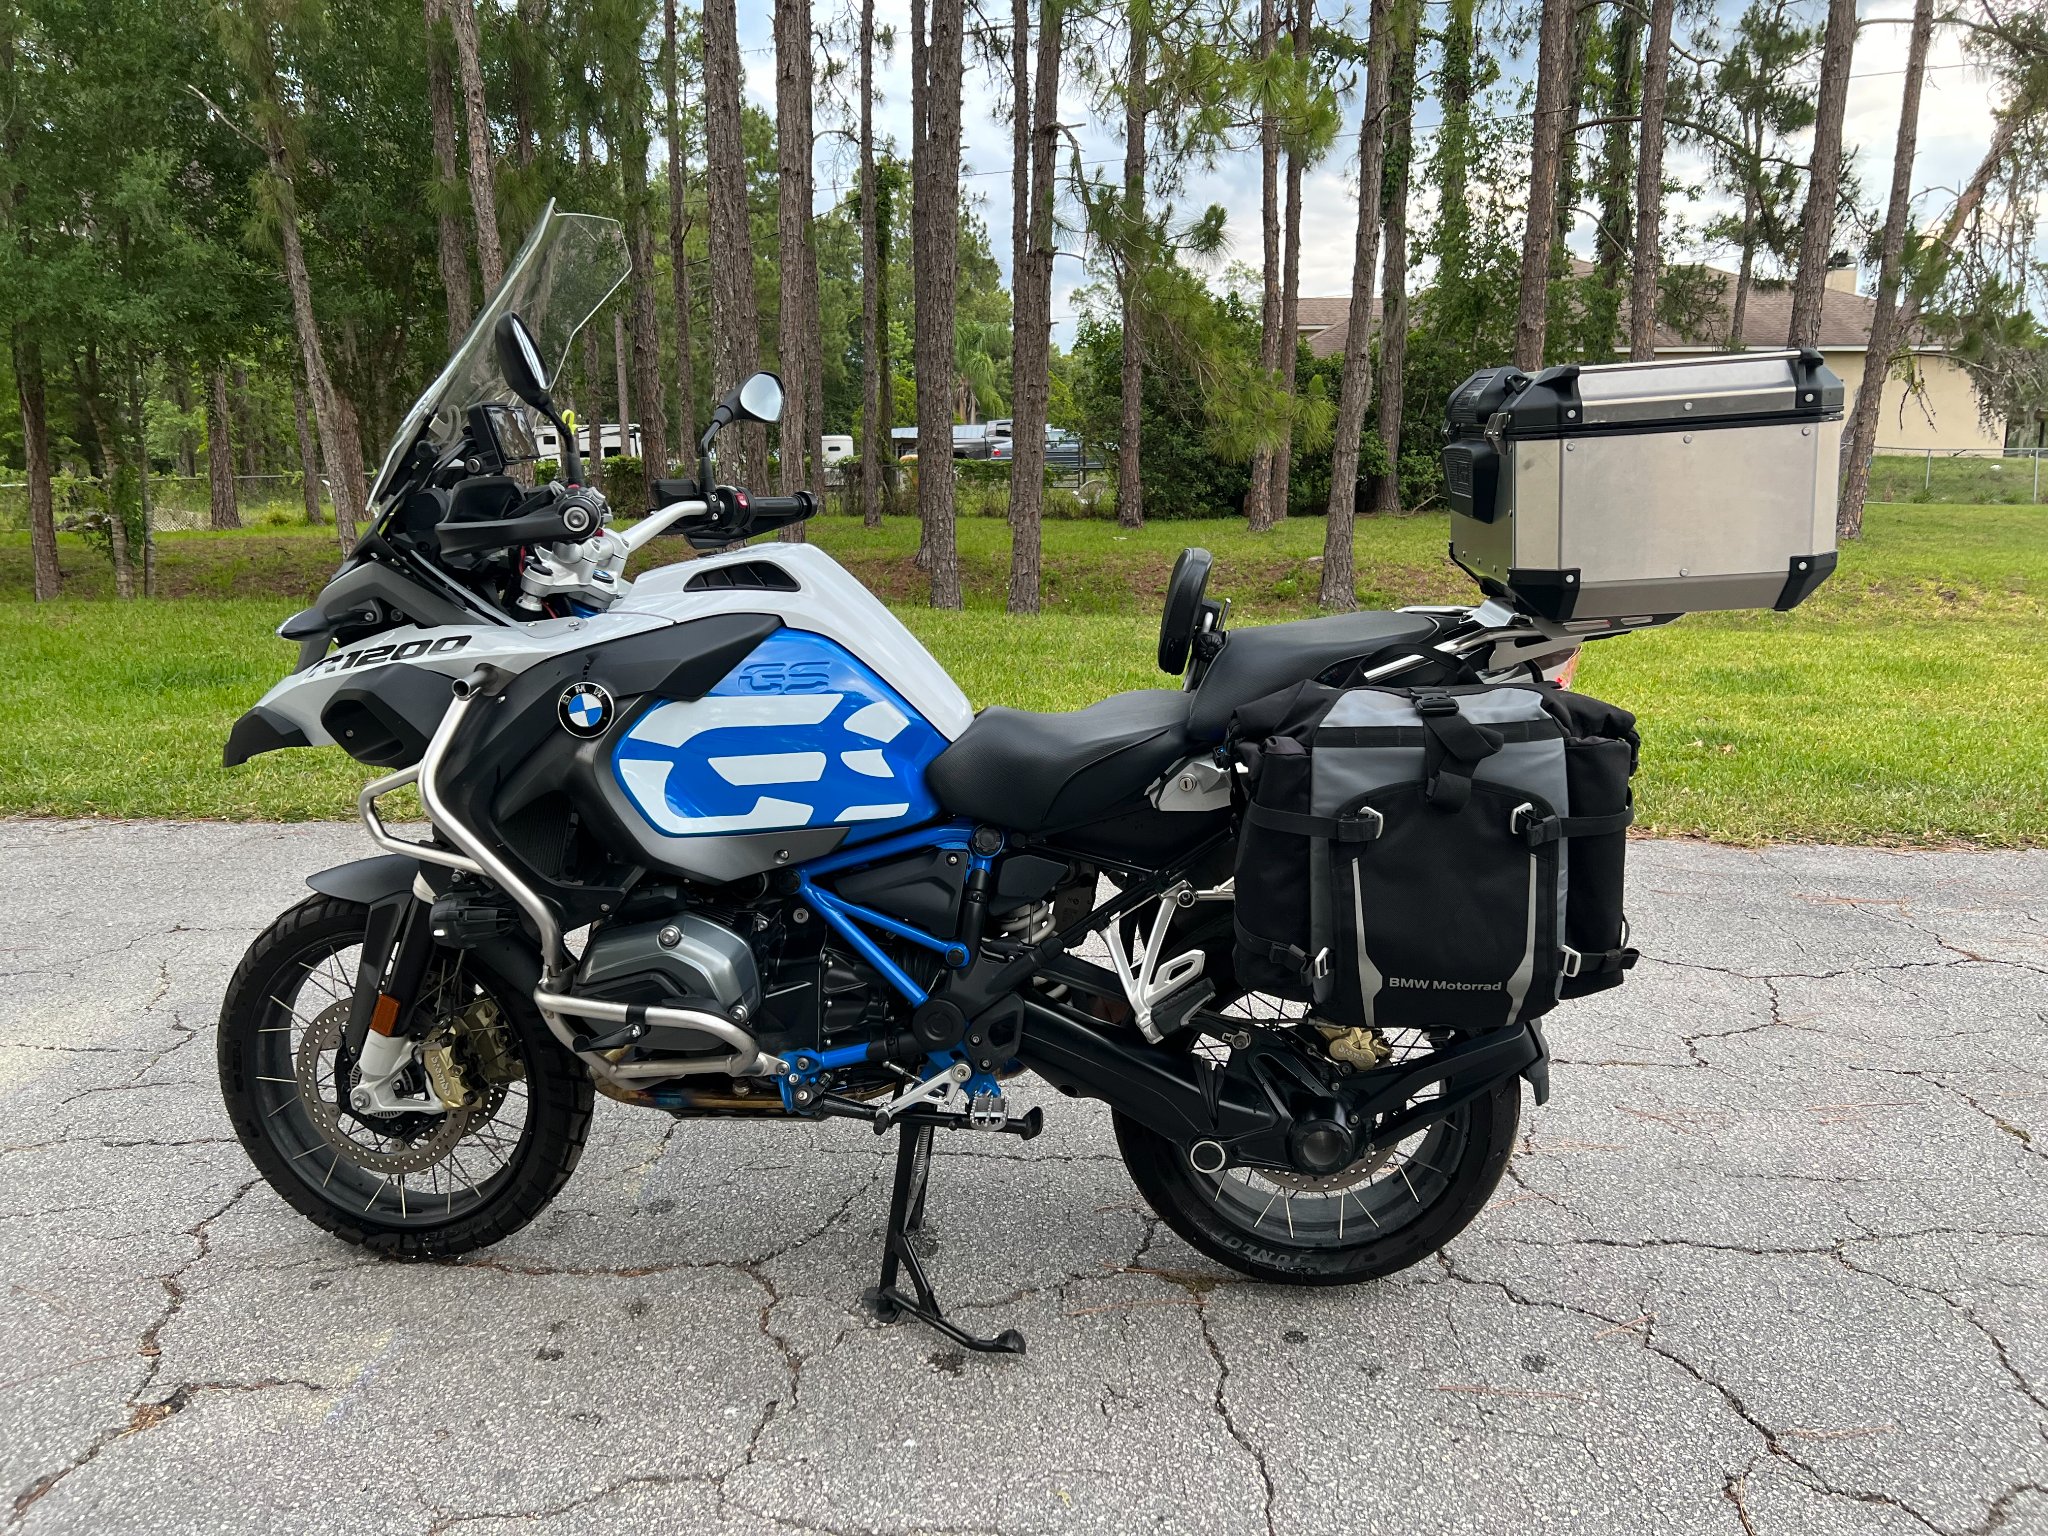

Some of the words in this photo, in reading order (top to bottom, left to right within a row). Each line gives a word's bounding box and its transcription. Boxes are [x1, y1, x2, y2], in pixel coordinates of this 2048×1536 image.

[559, 684, 607, 706] BMW
[1389, 977, 1430, 990] BMW
[1433, 980, 1503, 991] Motorrad
